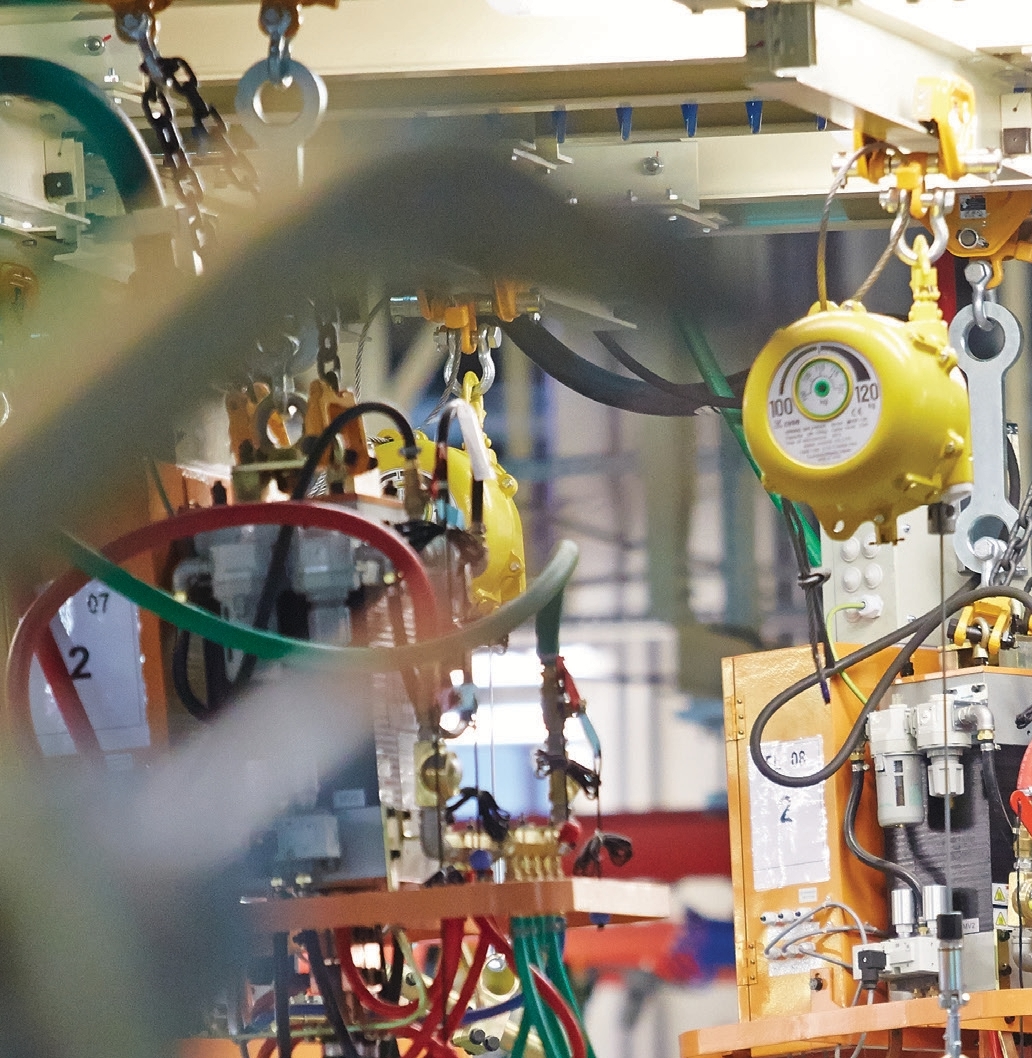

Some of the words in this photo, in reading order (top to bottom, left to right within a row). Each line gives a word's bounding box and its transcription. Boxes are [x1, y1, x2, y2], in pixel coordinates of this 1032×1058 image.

[855, 383, 879, 403] 120
[769, 397, 793, 418] 100
[86, 592, 110, 614] 07
[68, 645, 92, 680] 2
